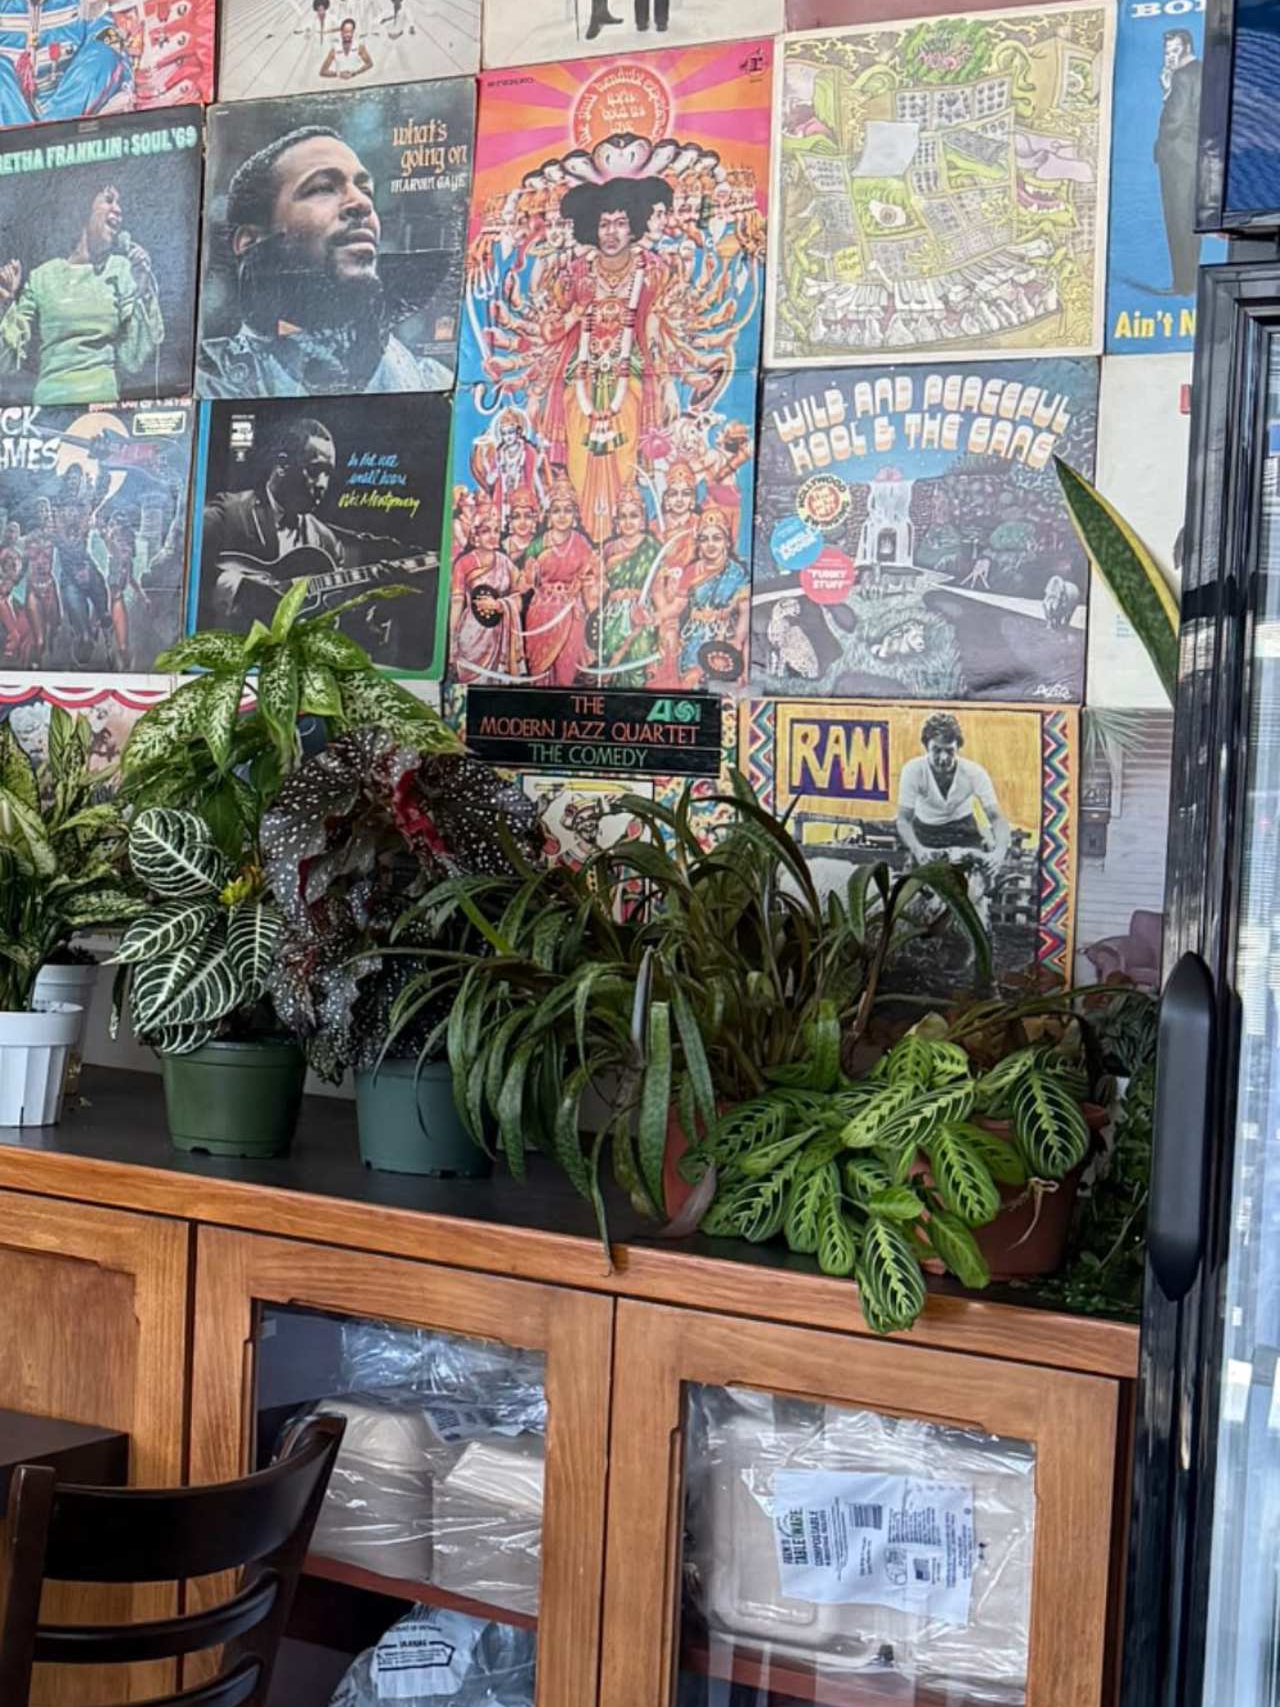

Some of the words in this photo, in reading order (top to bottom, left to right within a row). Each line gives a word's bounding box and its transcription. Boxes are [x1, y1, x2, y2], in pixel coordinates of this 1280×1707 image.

[130, 131, 172, 156] SOUL
[172, 124, 199, 151] '69
[392, 117, 448, 147] what's
[400, 145, 446, 177] going
[447, 144, 468, 167] on
[1114, 308, 1175, 339] Ain't
[772, 388, 847, 443] WILD
[853, 375, 914, 419] AND
[923, 374, 1073, 436] PEACEFUL
[789, 420, 868, 477] KOOL
[873, 416, 896, 452] &
[903, 412, 965, 452] THE
[968, 416, 1057, 471] GANG
[571, 695, 606, 716] THE
[479, 716, 556, 738] MODERN
[561, 719, 606, 741] JAZZ
[610, 722, 701, 746] QUARTET
[527, 742, 566, 764] THE
[568, 745, 649, 768] COMEDY
[790, 721, 888, 792] RAM
